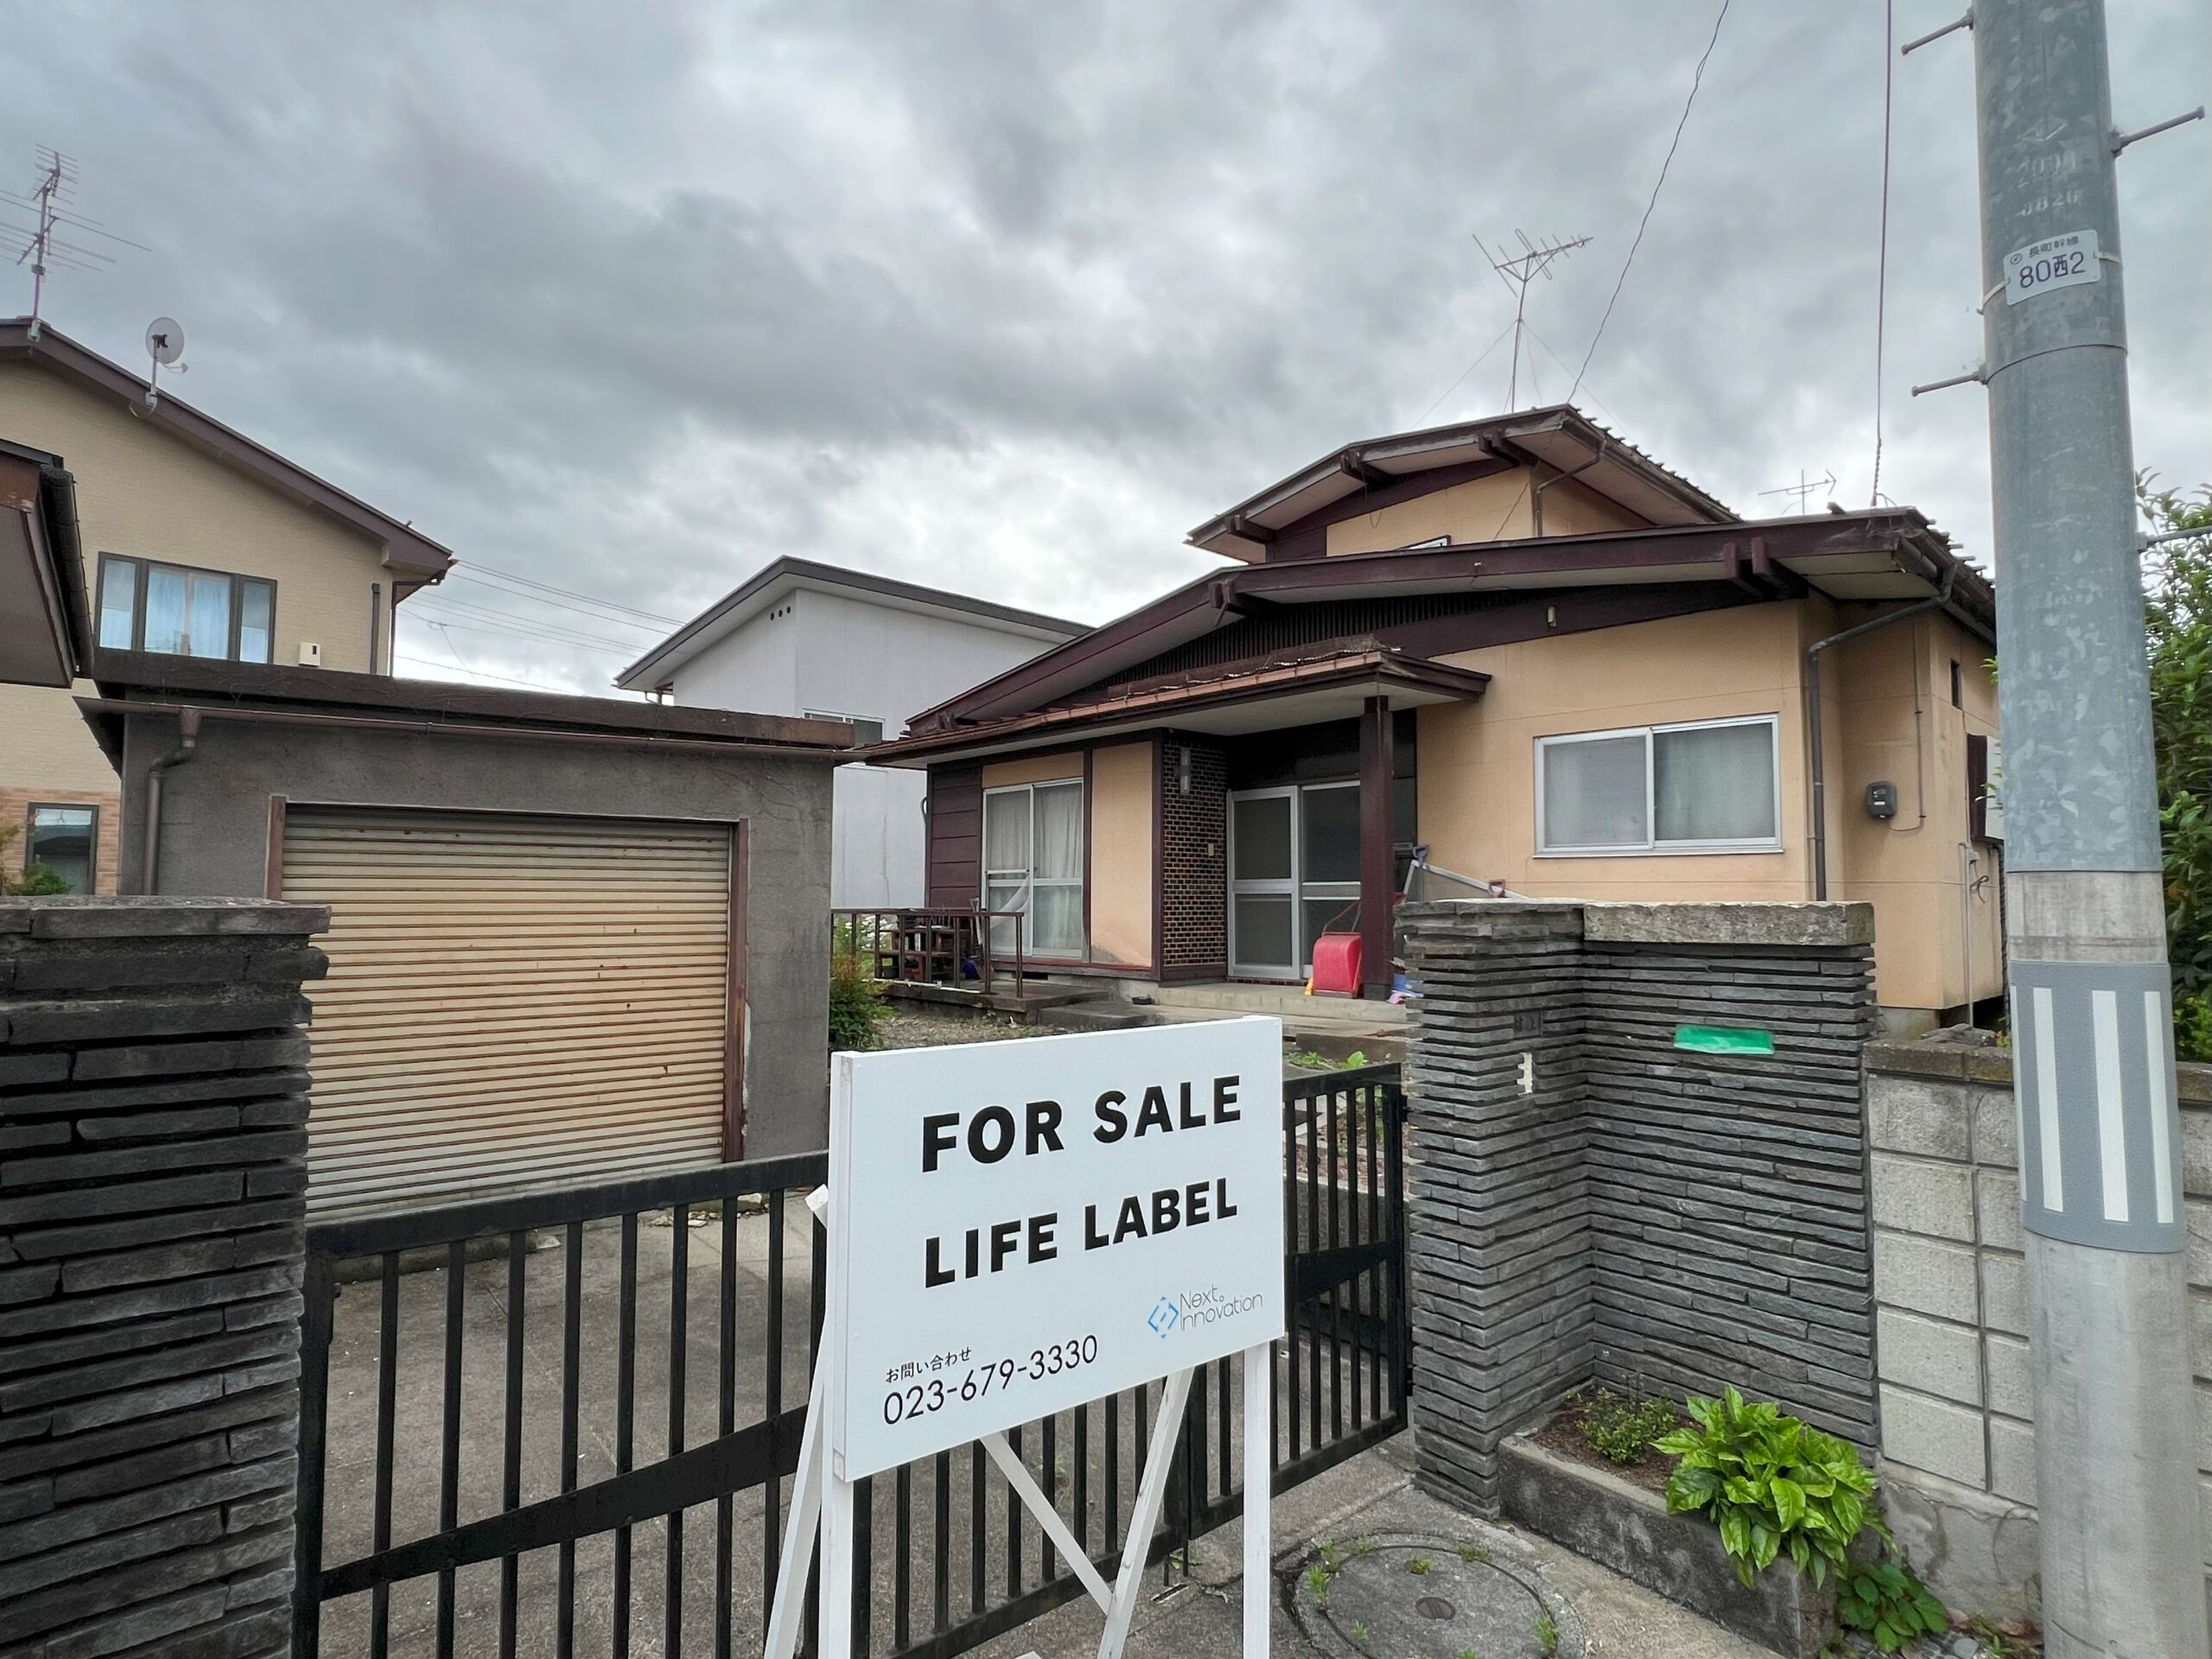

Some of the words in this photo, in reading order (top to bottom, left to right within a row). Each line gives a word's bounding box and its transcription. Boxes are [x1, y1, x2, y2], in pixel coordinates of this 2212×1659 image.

[2019, 251, 2086, 289] 80西2
[921, 1099, 1065, 1173] FOR
[1092, 1074, 1242, 1144] SALE
[925, 1212, 1058, 1288] LIFE
[1084, 1177, 1238, 1251] LABEL
[1179, 1293, 1264, 1332] Innovation
[883, 1334, 1098, 1426] 023-679-3330
[885, 1345, 973, 1383] お問い合わせ
